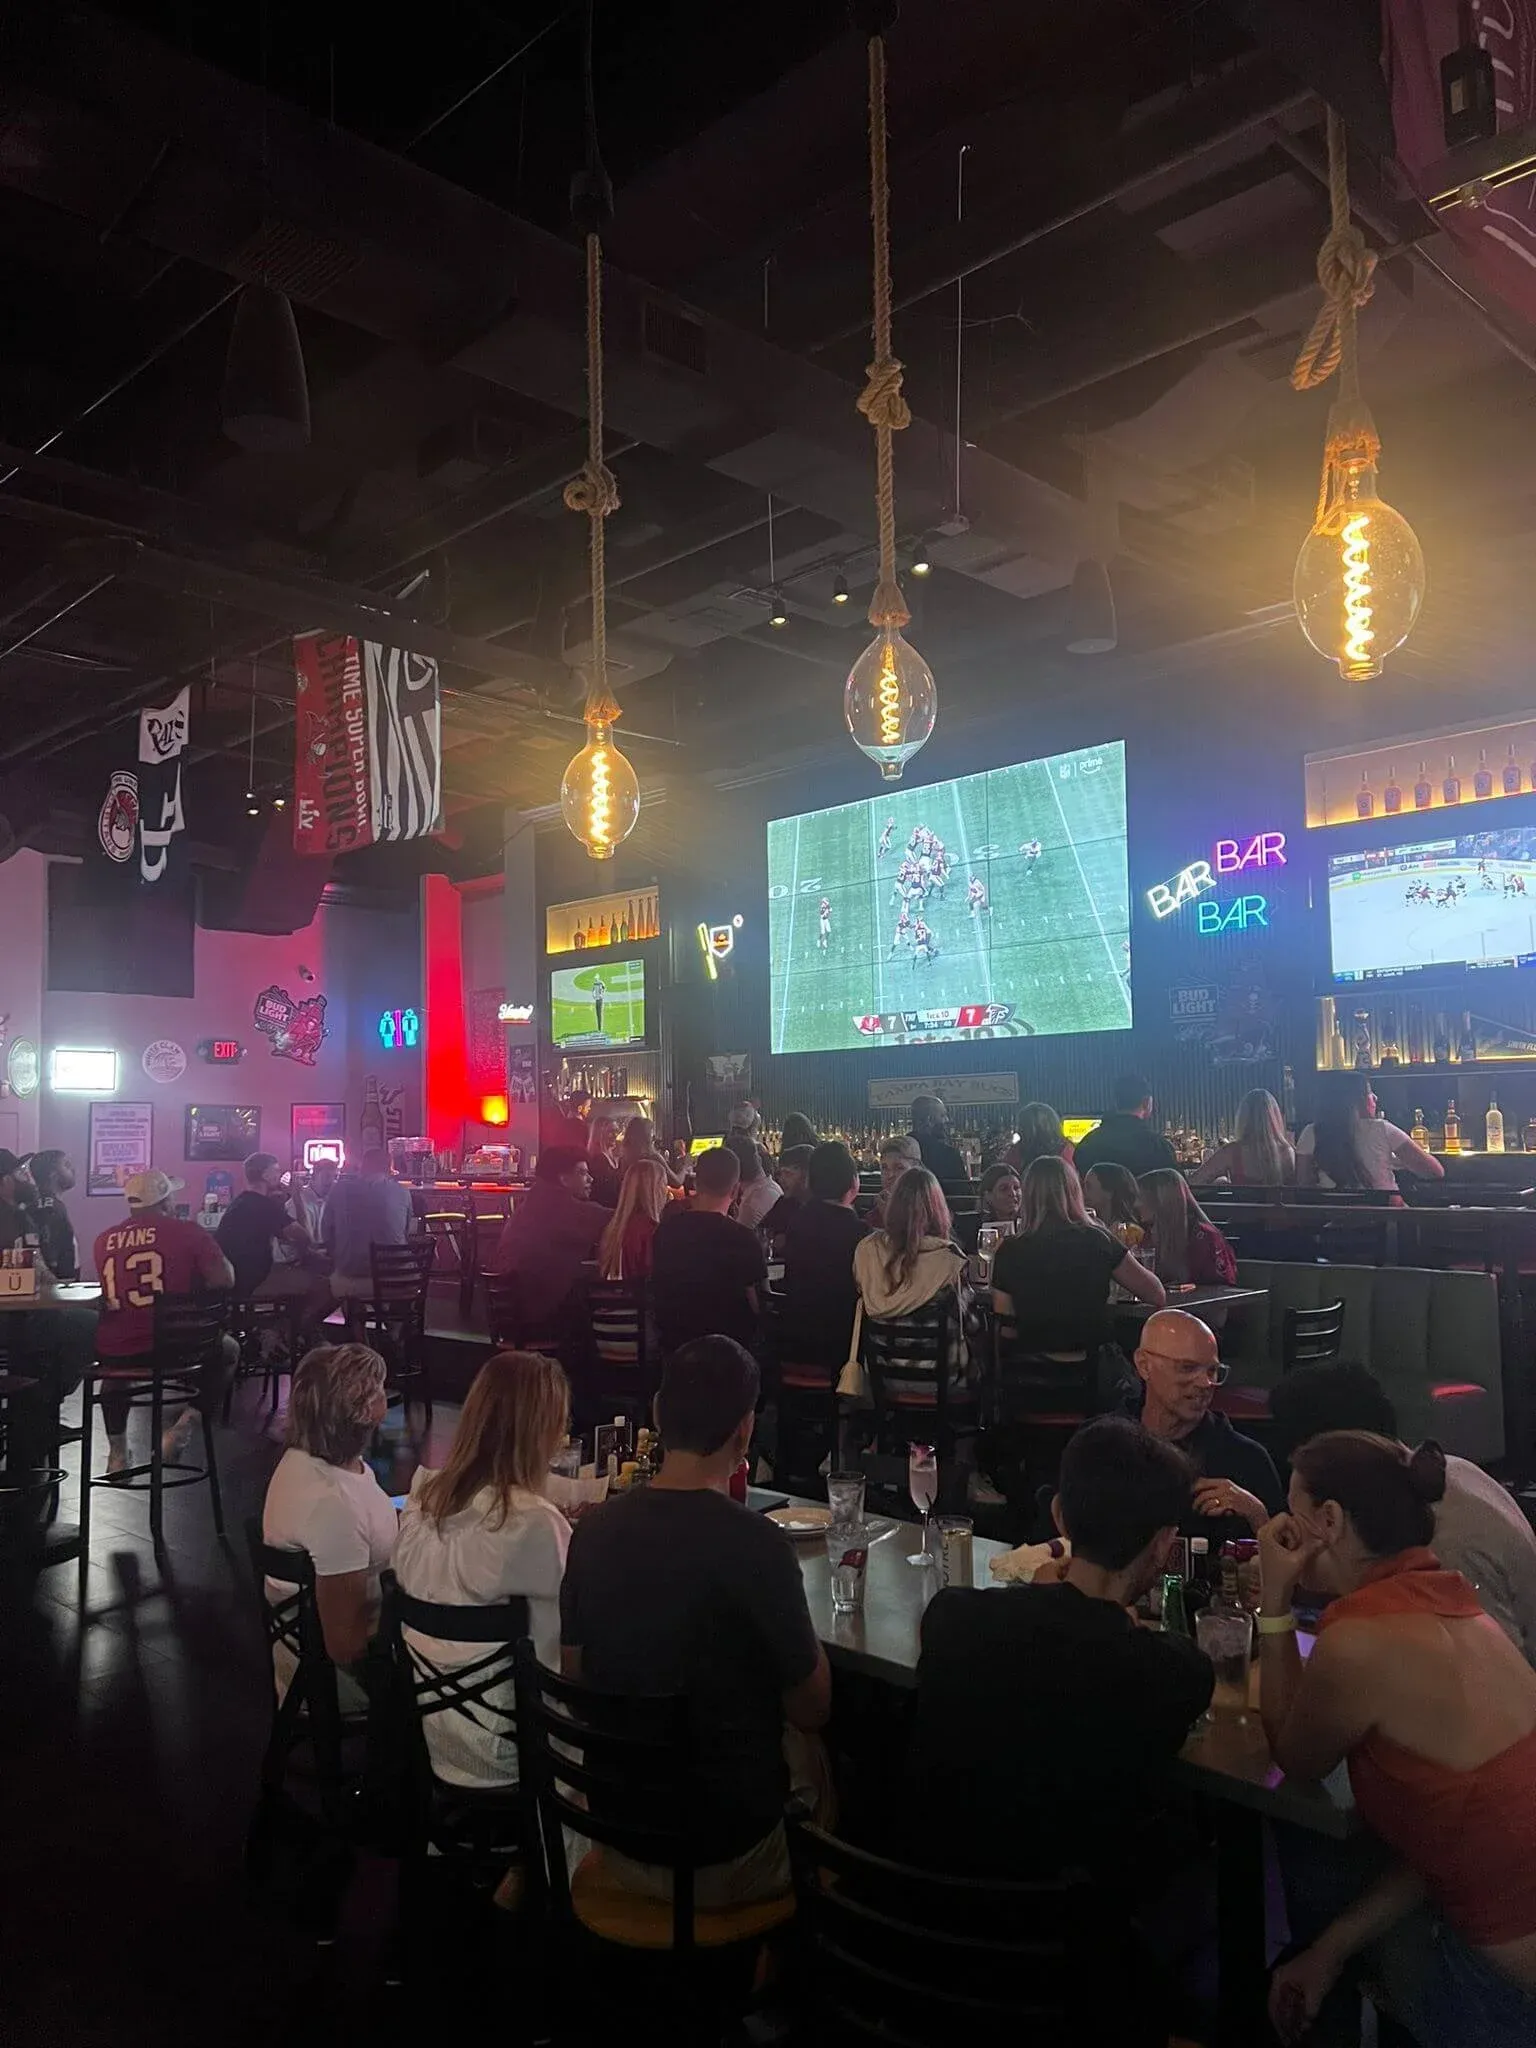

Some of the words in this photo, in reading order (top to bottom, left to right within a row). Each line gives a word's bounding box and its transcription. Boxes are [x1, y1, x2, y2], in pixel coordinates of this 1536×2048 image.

[342, 652, 362, 703] TIME
[1216, 831, 1287, 873] BAR
[1147, 860, 1217, 918] BAR
[1198, 895, 1268, 933] BAR
[1178, 988, 1209, 1002] BUD
[259, 1006, 289, 1023] LIGHT
[264, 999, 287, 1013] BUD
[1172, 999, 1216, 1014] LIGHT
[887, 1016, 897, 1030] 7
[965, 1008, 976, 1024] 7
[214, 1041, 235, 1058] EXIT
[873, 1082, 929, 1102] TAMPA
[933, 1079, 966, 1088] BAY
[37, 1197, 54, 1209] 12
[106, 1227, 157, 1251] EVANS
[8, 1272, 22, 1291] Ü
[102, 1251, 164, 1311] 13
